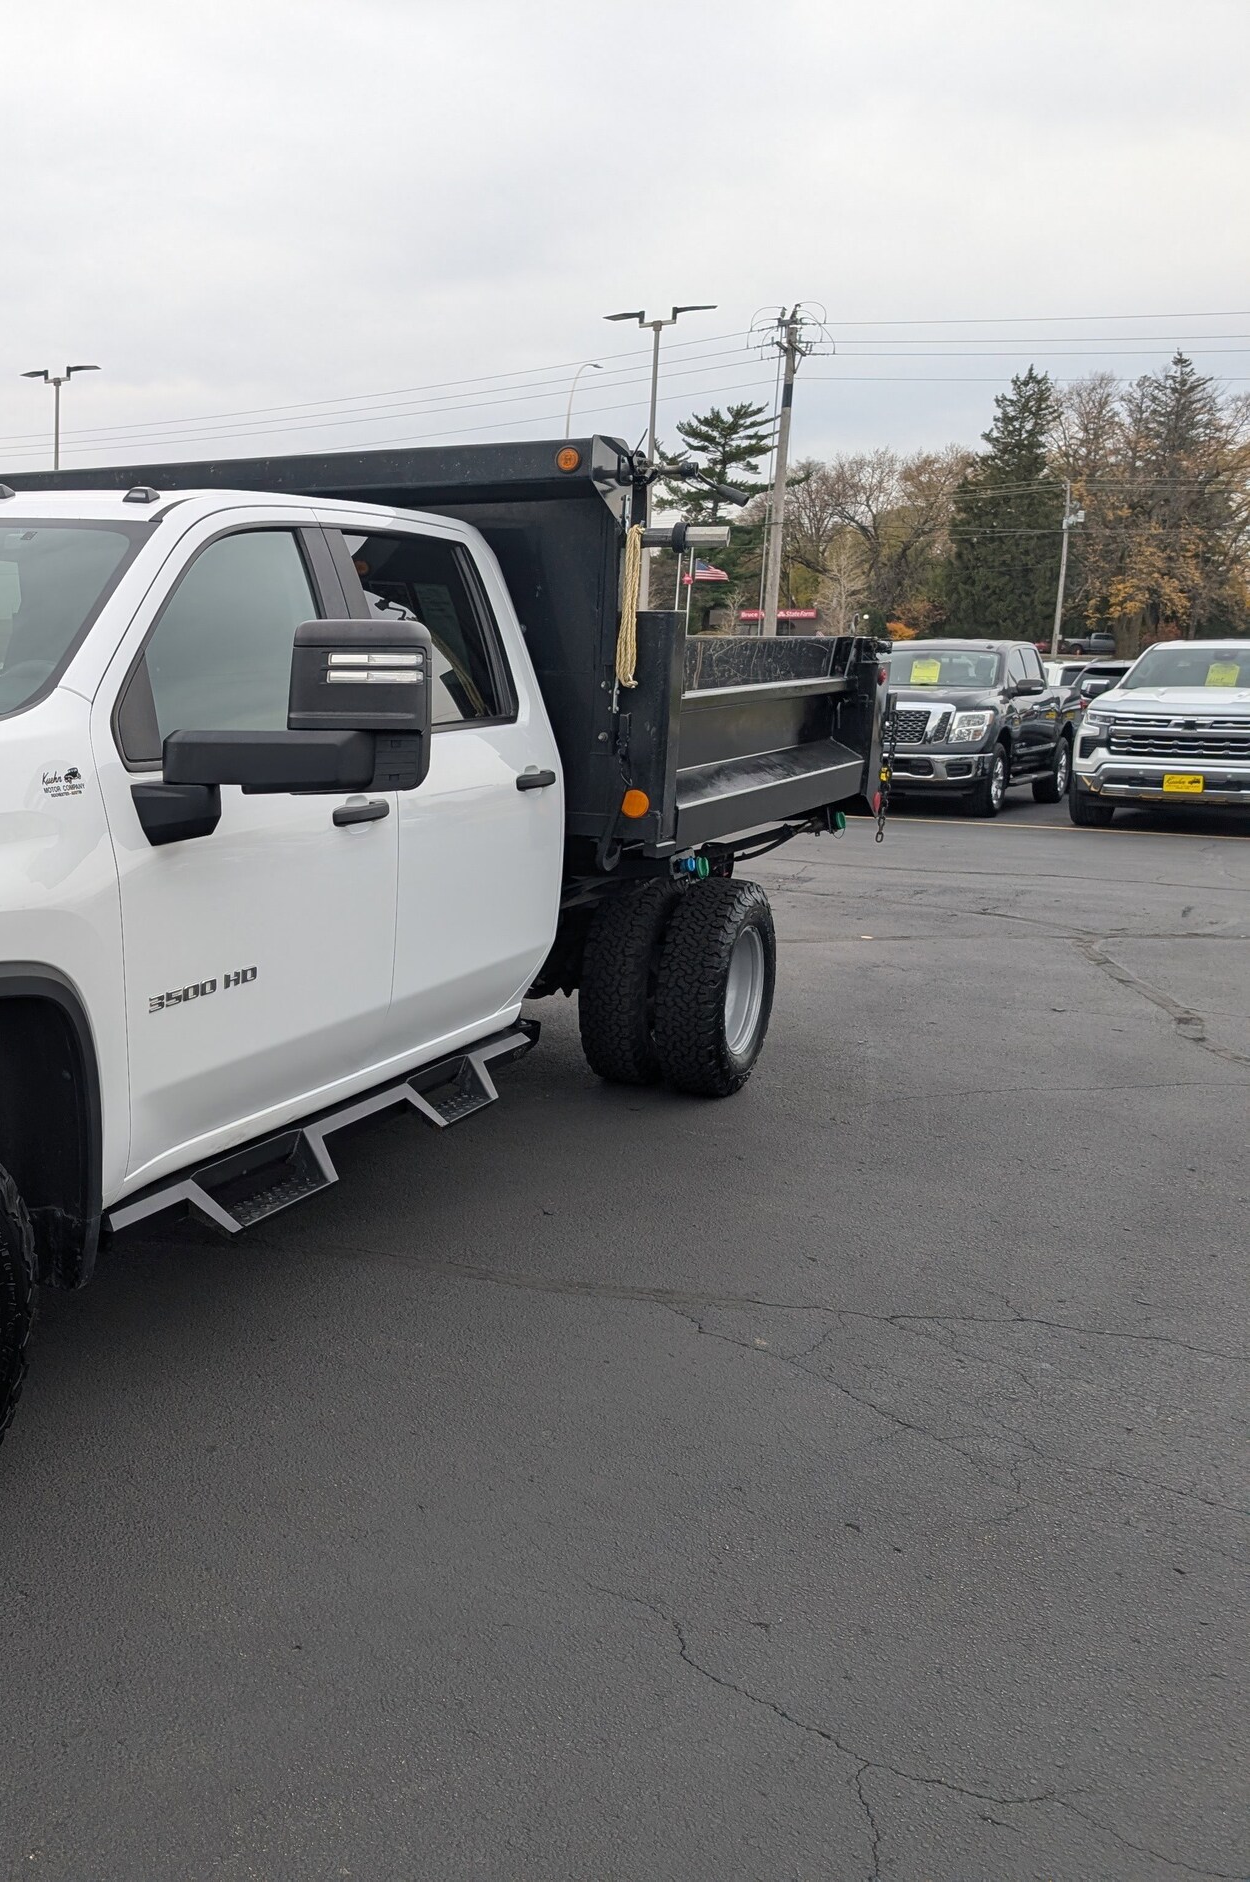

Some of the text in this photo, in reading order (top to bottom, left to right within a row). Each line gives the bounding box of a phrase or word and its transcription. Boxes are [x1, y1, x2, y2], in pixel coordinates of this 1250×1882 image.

[42, 771, 62, 785] Kuehn
[63, 783, 85, 791] COMPANY
[149, 966, 257, 1014] 3500 HD
